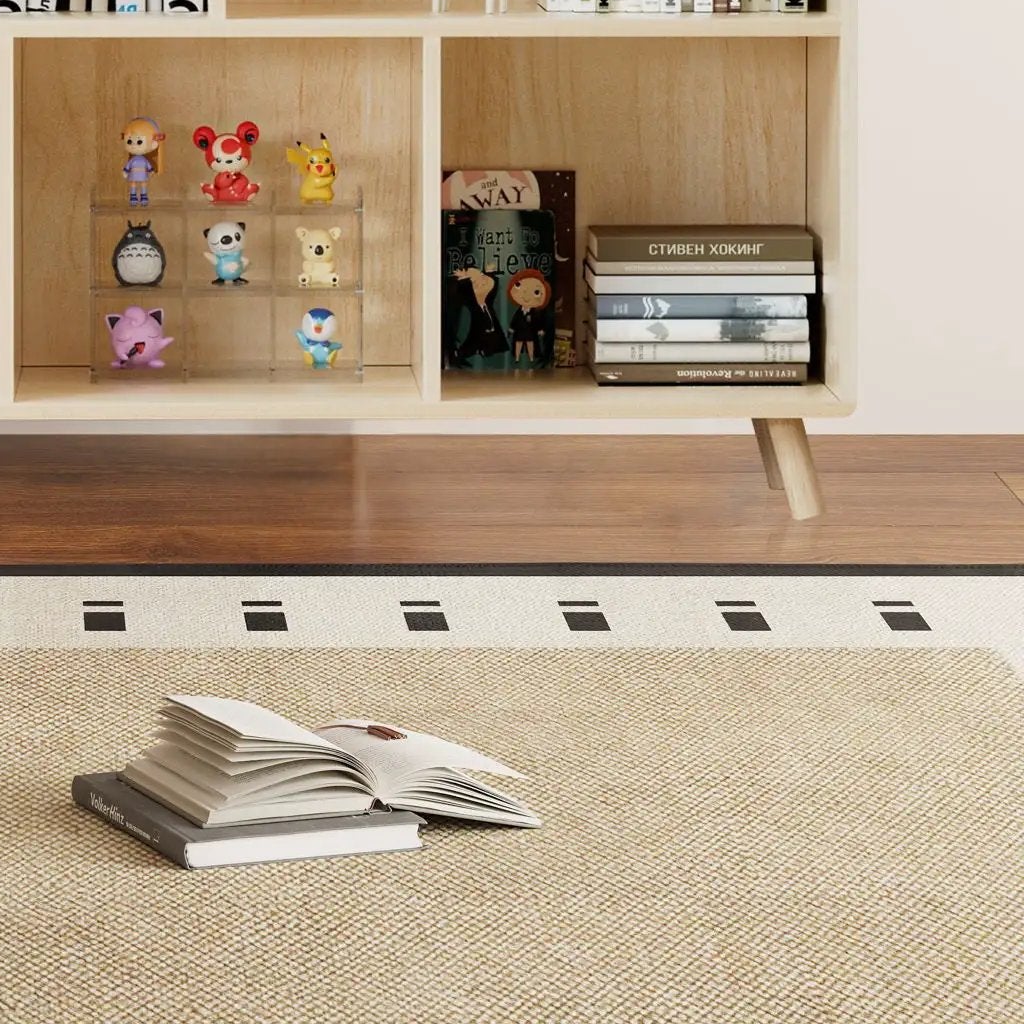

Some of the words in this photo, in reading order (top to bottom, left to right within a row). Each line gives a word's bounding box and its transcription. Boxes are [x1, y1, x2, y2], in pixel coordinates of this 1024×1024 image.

[480, 177, 498, 189] and
[460, 186, 527, 210] AWAY
[458, 227, 469, 247] I
[477, 228, 514, 245] Want
[520, 226, 540, 247] To
[648, 243, 705, 256] СТИВЕН
[709, 243, 766, 256] ХОКИНГ
[447, 246, 553, 276] Believe
[677, 369, 732, 378] Revolution
[749, 369, 797, 377] REVEALING
